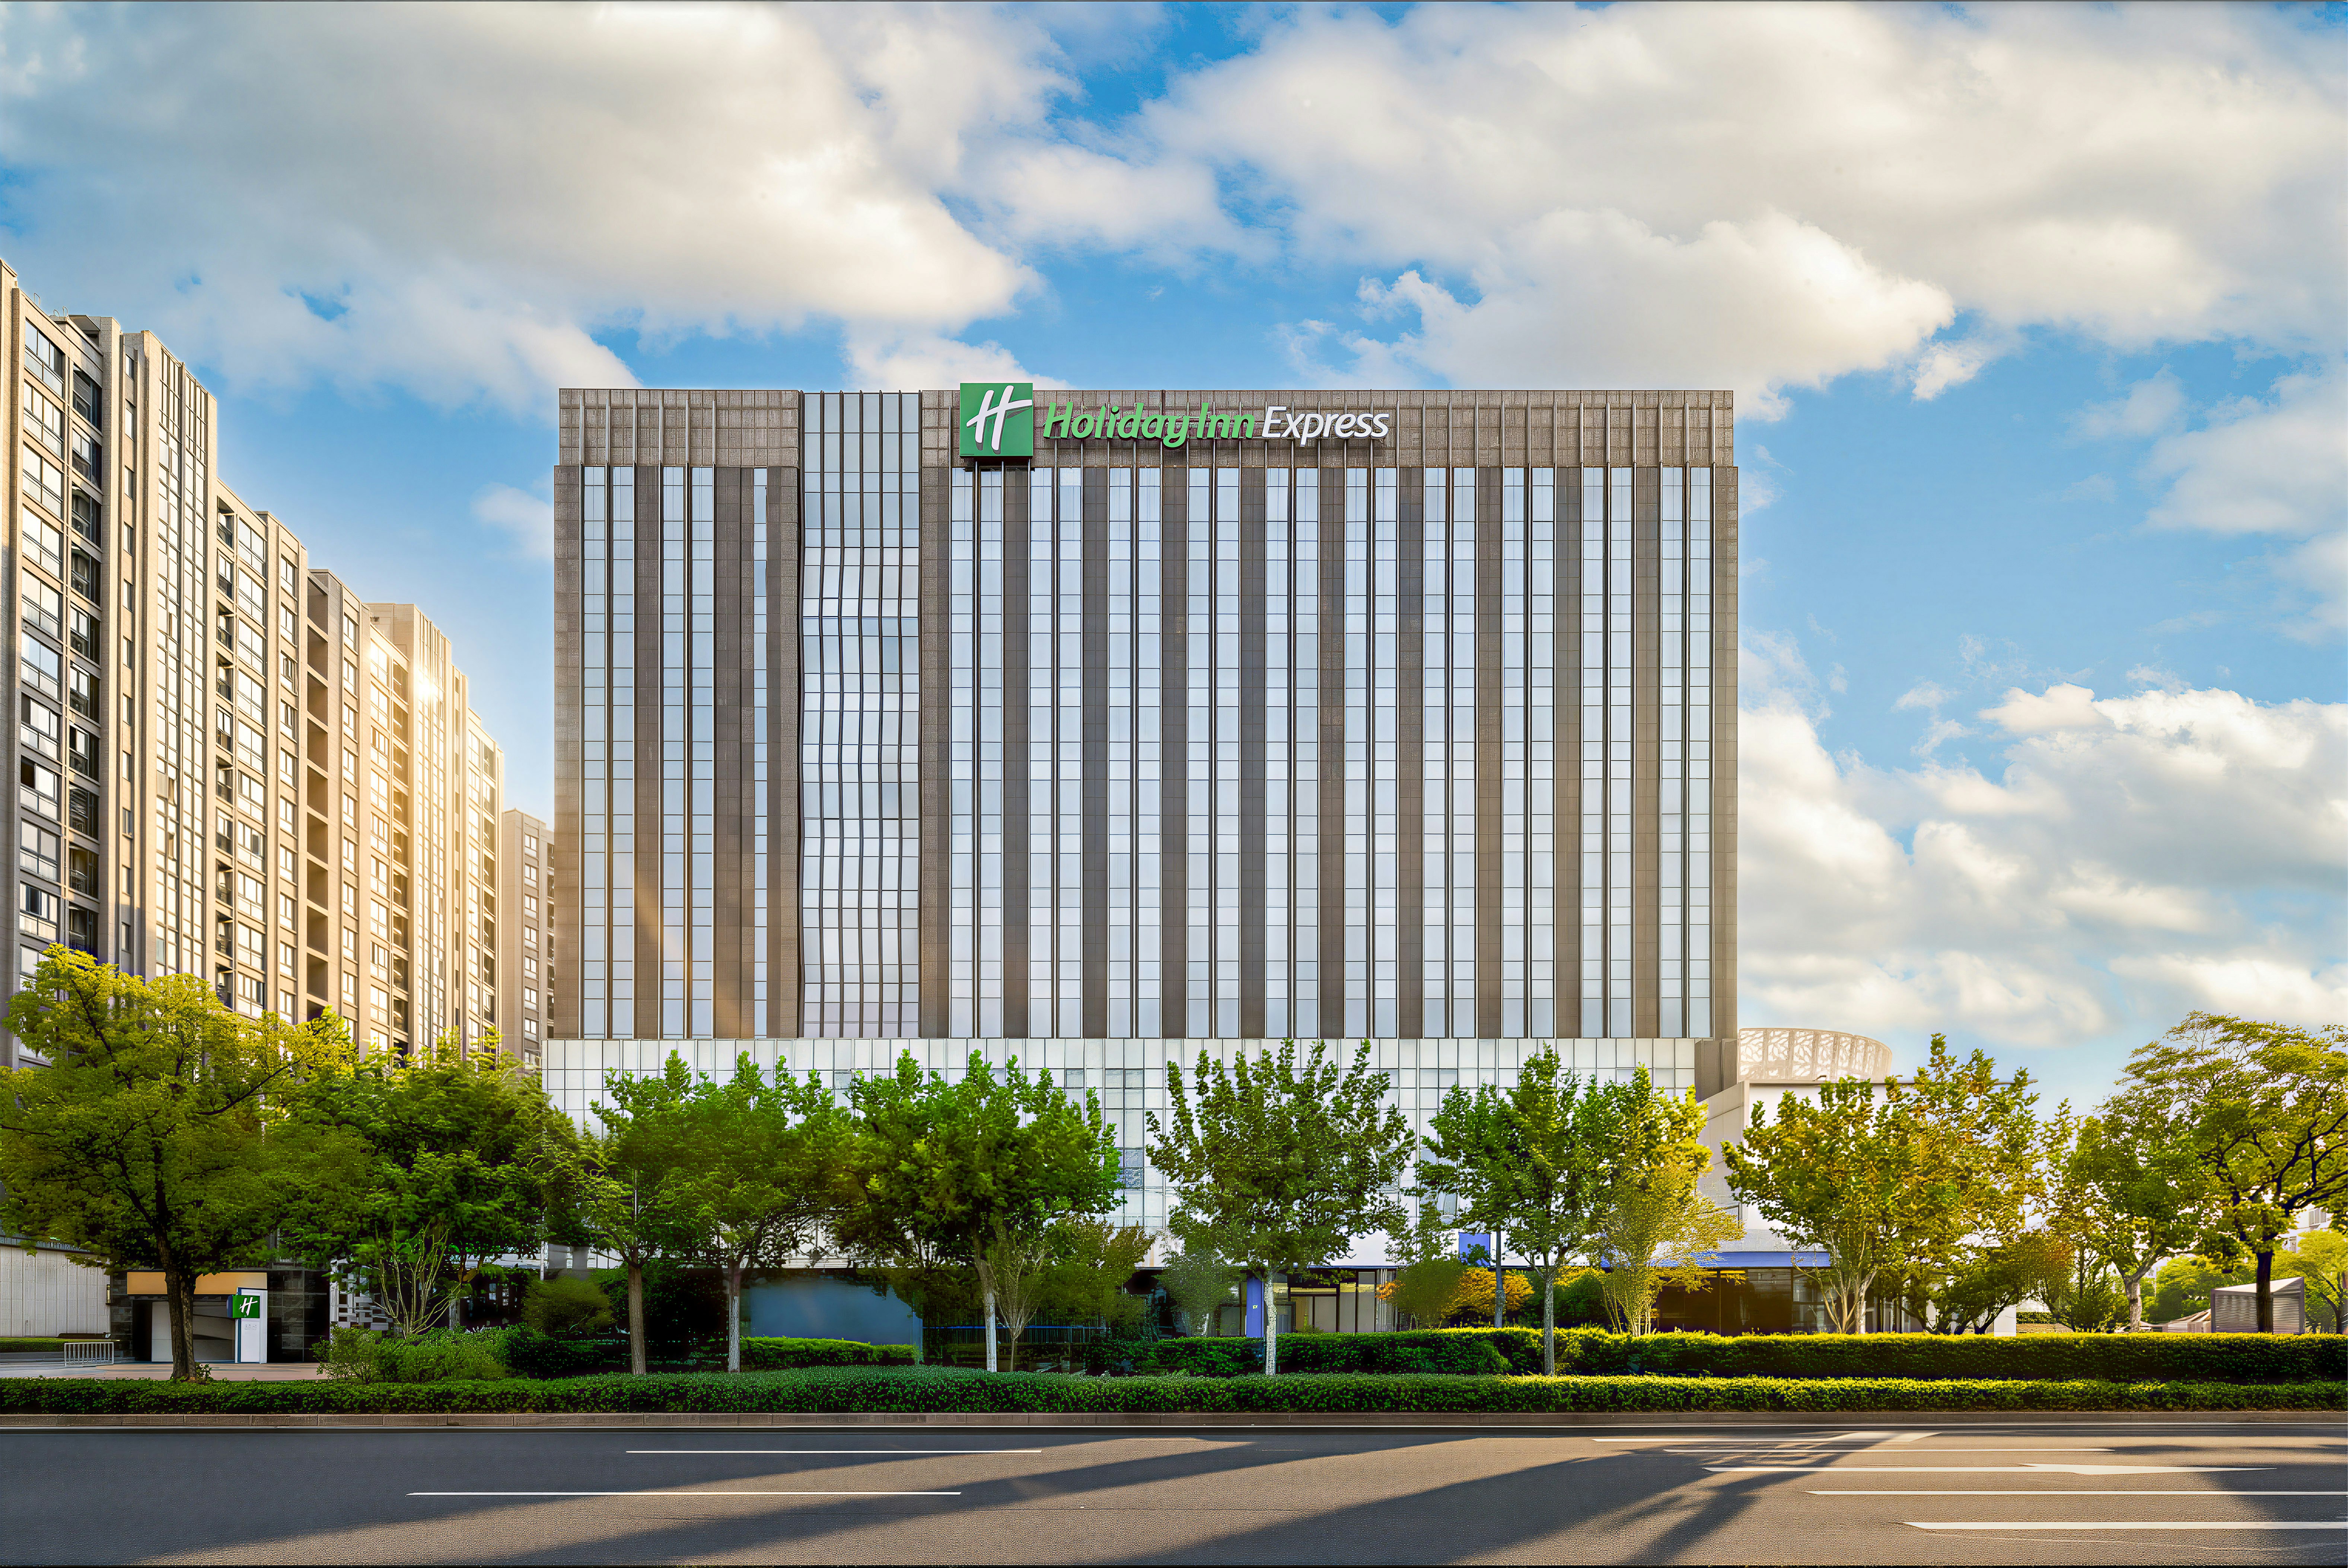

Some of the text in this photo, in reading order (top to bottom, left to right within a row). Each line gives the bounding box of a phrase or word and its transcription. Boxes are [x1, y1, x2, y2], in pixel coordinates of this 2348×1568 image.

[966, 385, 1032, 451] H
[1043, 402, 1389, 448] Holiday Inn Express
[239, 1297, 258, 1316] H
